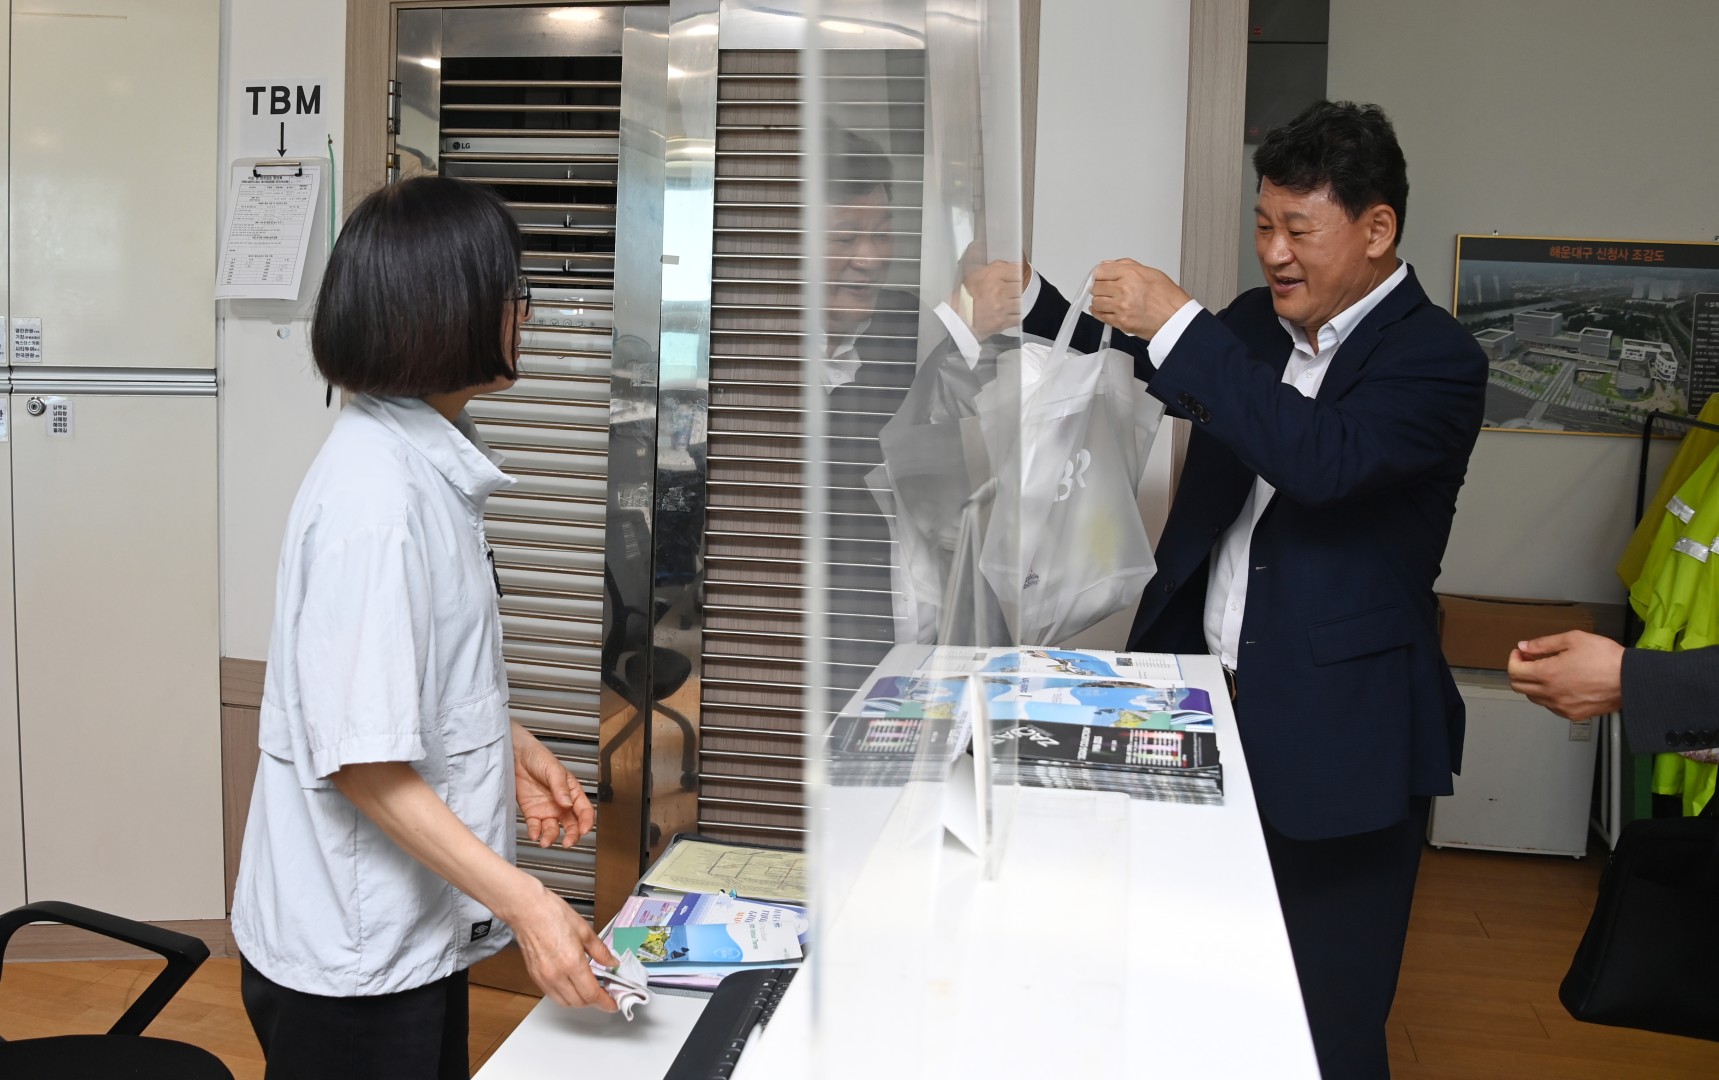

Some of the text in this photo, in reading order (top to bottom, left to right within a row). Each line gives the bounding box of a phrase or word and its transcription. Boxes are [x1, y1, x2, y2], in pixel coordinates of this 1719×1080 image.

[245, 85, 321, 115] TBM
[461, 142, 471, 150] LG
[1549, 245, 1665, 262] 해운대구 신청사 조감도
